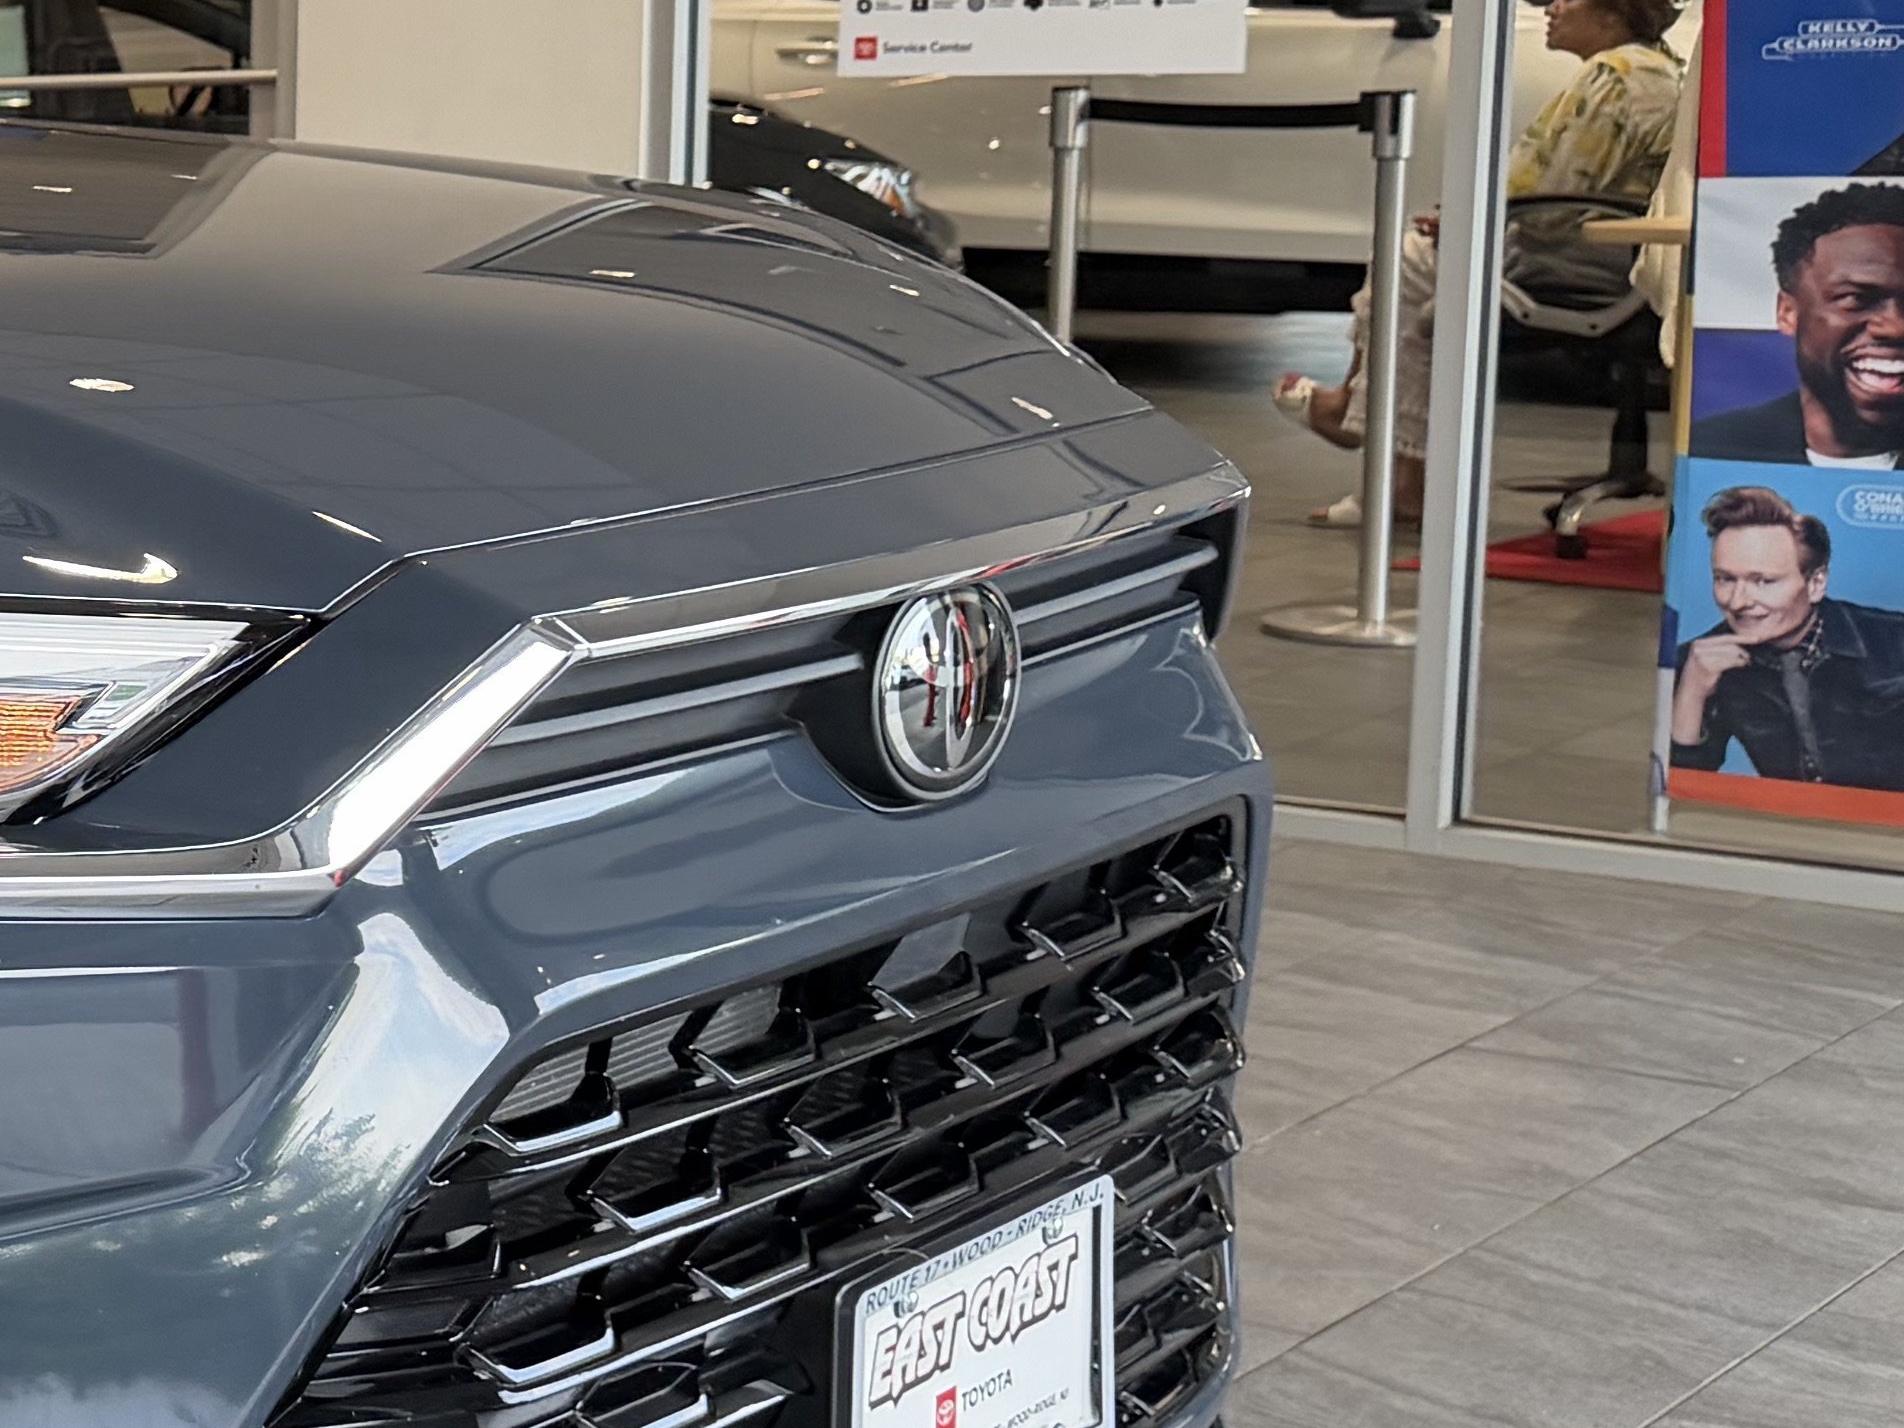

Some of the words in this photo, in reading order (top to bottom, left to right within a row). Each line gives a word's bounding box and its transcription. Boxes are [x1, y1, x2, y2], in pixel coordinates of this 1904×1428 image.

[1808, 21, 1869, 33] KELLY
[882, 40, 927, 54] Service
[930, 39, 973, 54] Center
[1783, 36, 1893, 50] CLARKSON
[865, 1271, 921, 1314] ROUTE
[1072, 1184, 1104, 1210] N.J.
[869, 1290, 967, 1410] EAST
[968, 1233, 1079, 1353] COAST
[961, 1369, 1013, 1412] TOYOTA
